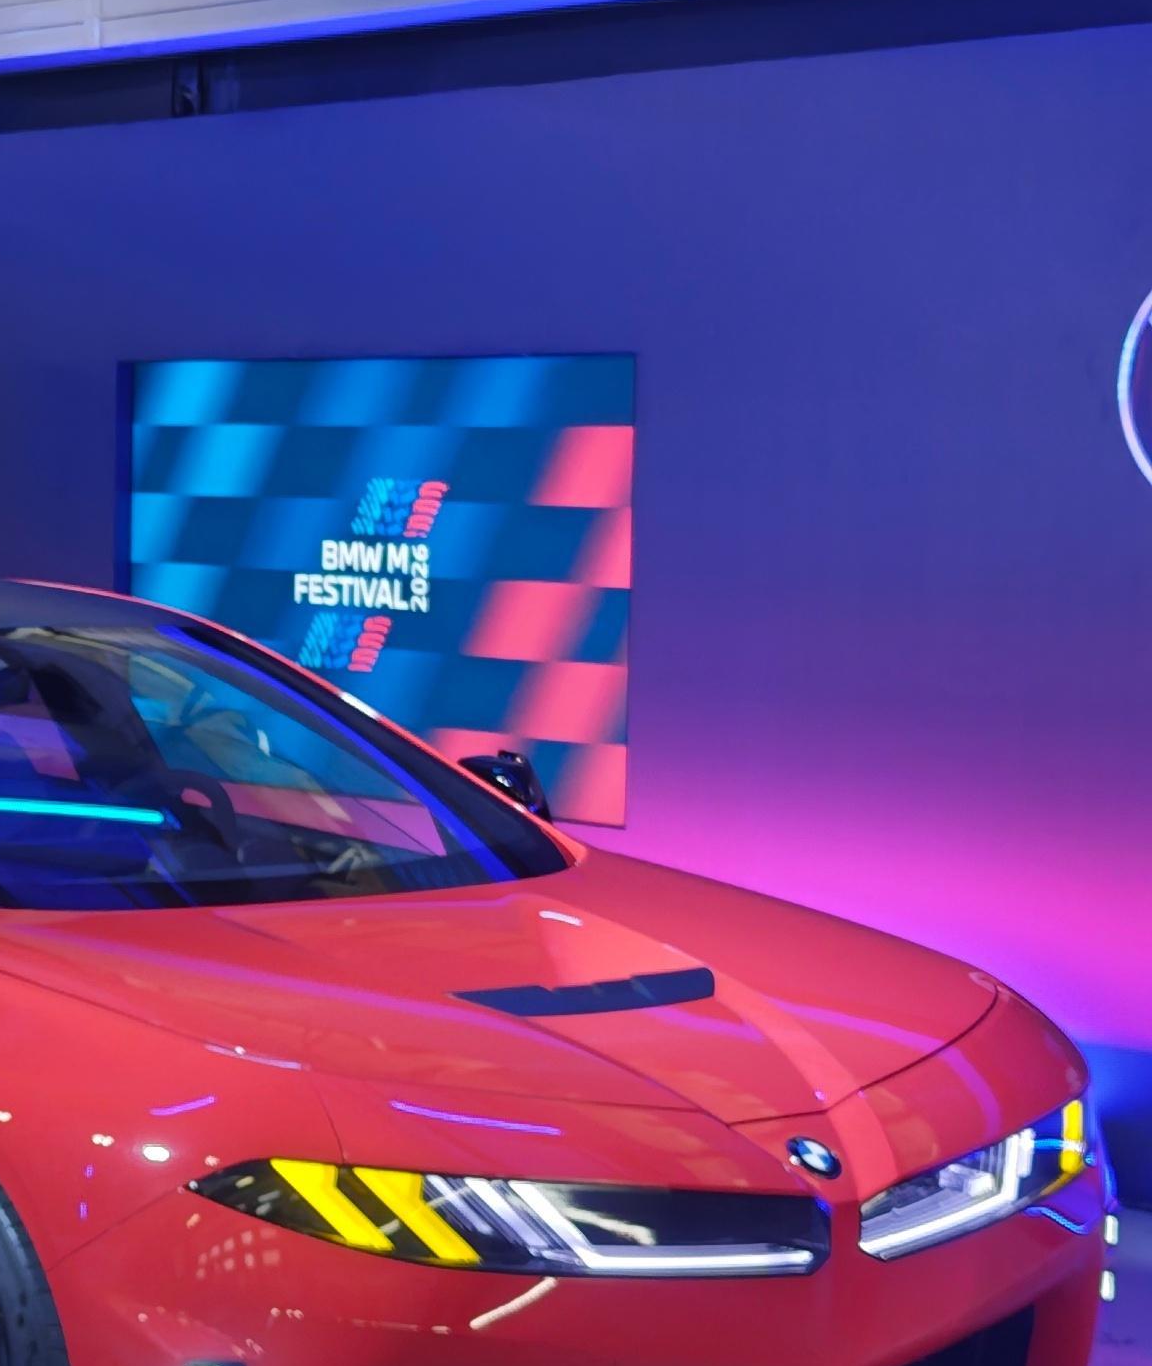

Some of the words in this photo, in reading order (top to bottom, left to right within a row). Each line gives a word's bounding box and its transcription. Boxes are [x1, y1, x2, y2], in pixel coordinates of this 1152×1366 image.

[322, 540, 383, 572] BMW
[387, 543, 410, 574] M
[294, 574, 409, 610] FESTIVAL
[410, 544, 430, 612] 2026
